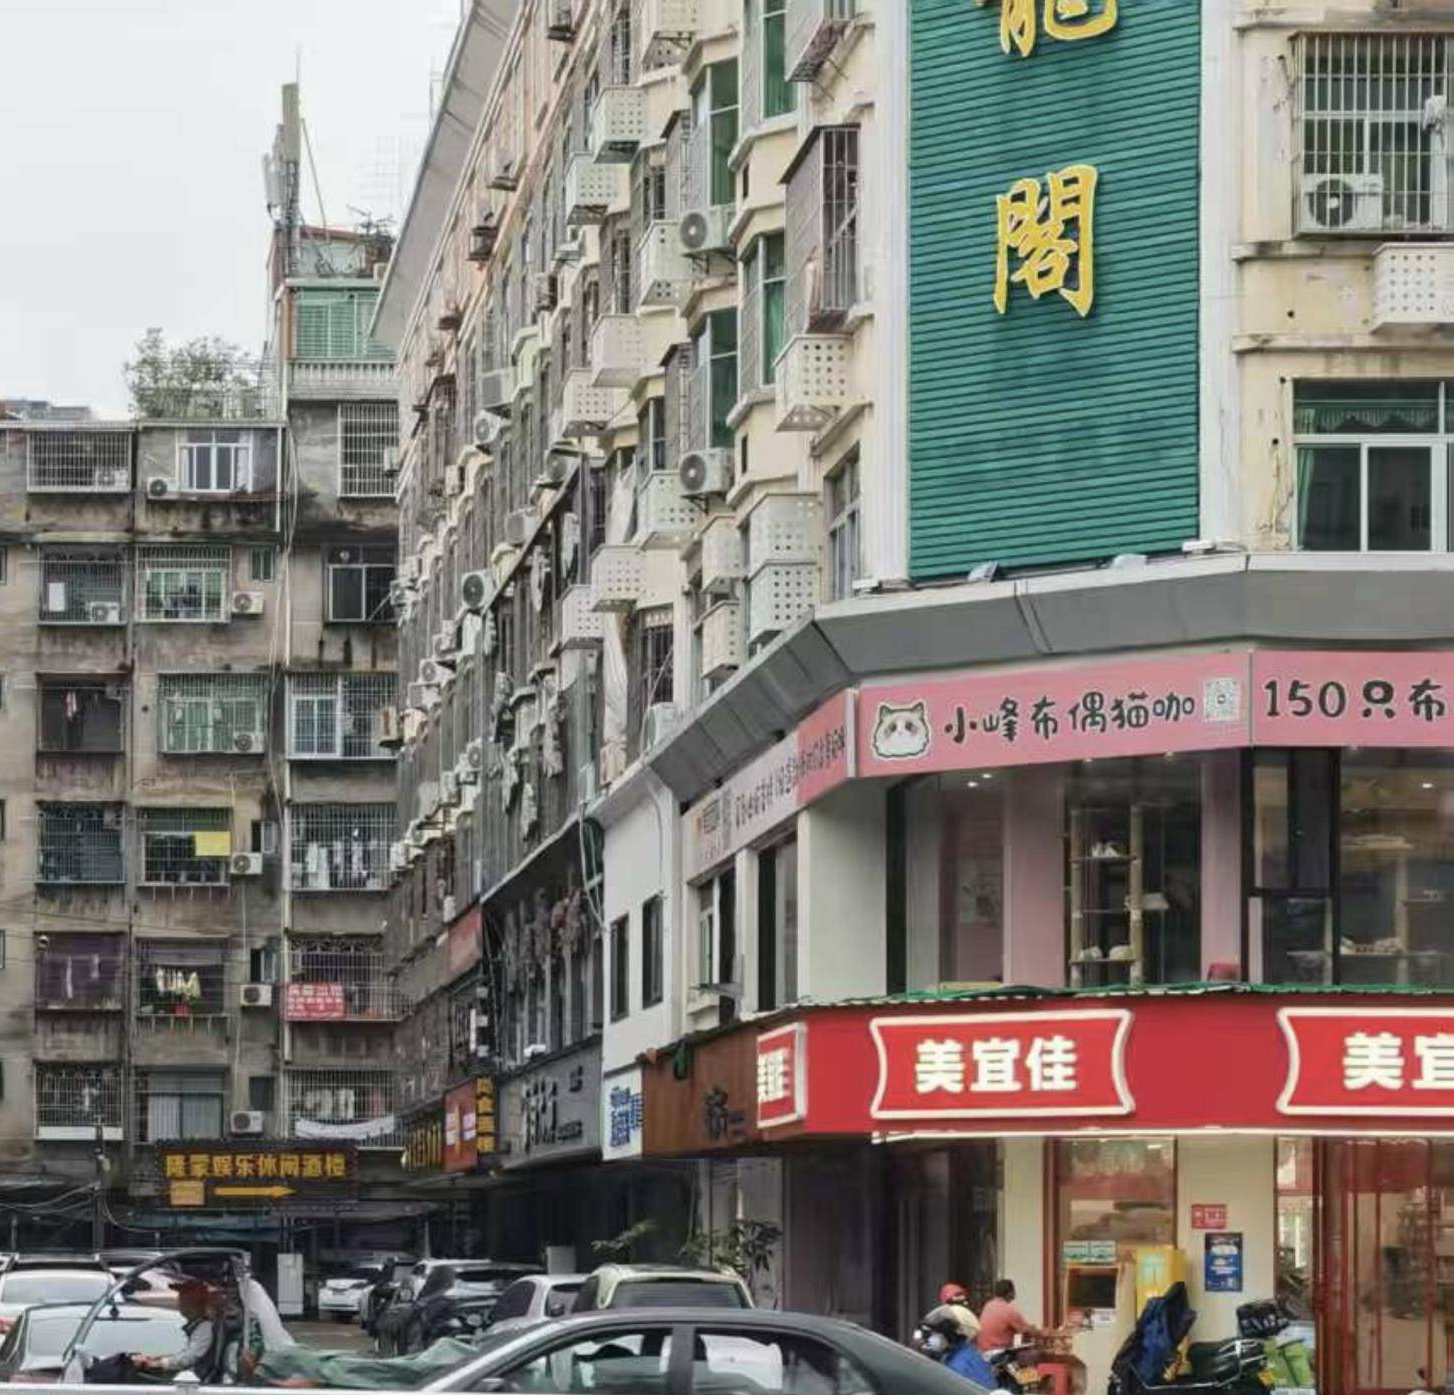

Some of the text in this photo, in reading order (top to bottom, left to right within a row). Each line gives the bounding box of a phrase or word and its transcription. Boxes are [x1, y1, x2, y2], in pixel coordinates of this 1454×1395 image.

[944, 690, 1194, 745] 小峰布偶猫咖
[915, 1036, 1077, 1094] 美宜佳
